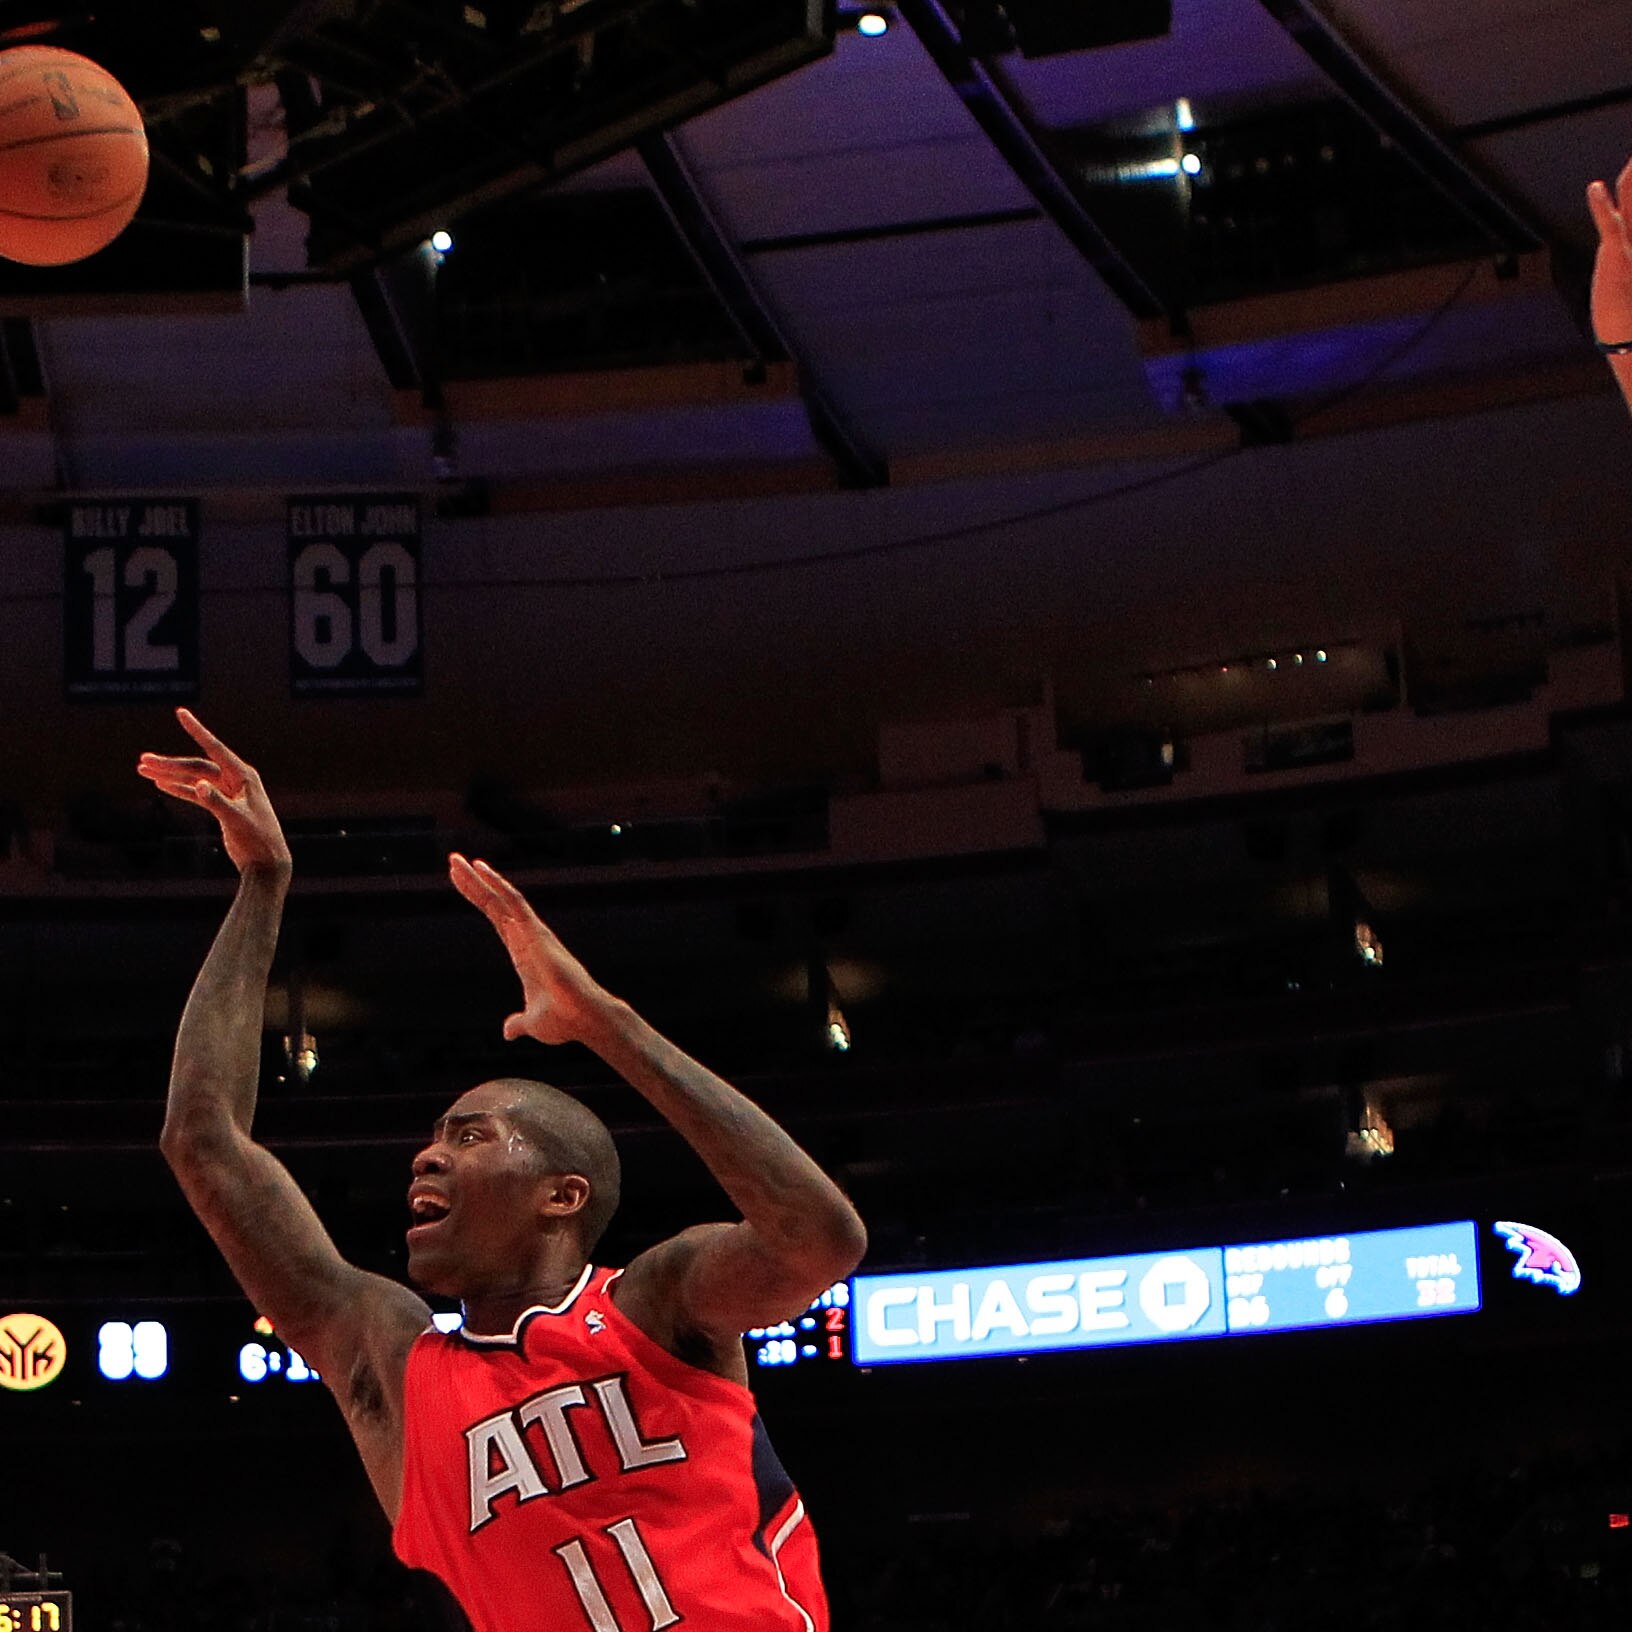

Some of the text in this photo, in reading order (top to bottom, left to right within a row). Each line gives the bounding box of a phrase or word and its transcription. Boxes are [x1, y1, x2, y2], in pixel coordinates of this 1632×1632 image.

[82, 547, 180, 670] 12
[293, 541, 417, 668] 60
[825, 1307, 845, 1331] 2
[867, 1270, 1131, 1347] CHASE
[239, 1342, 320, 1381] 6:1
[465, 1374, 688, 1533] ATL
